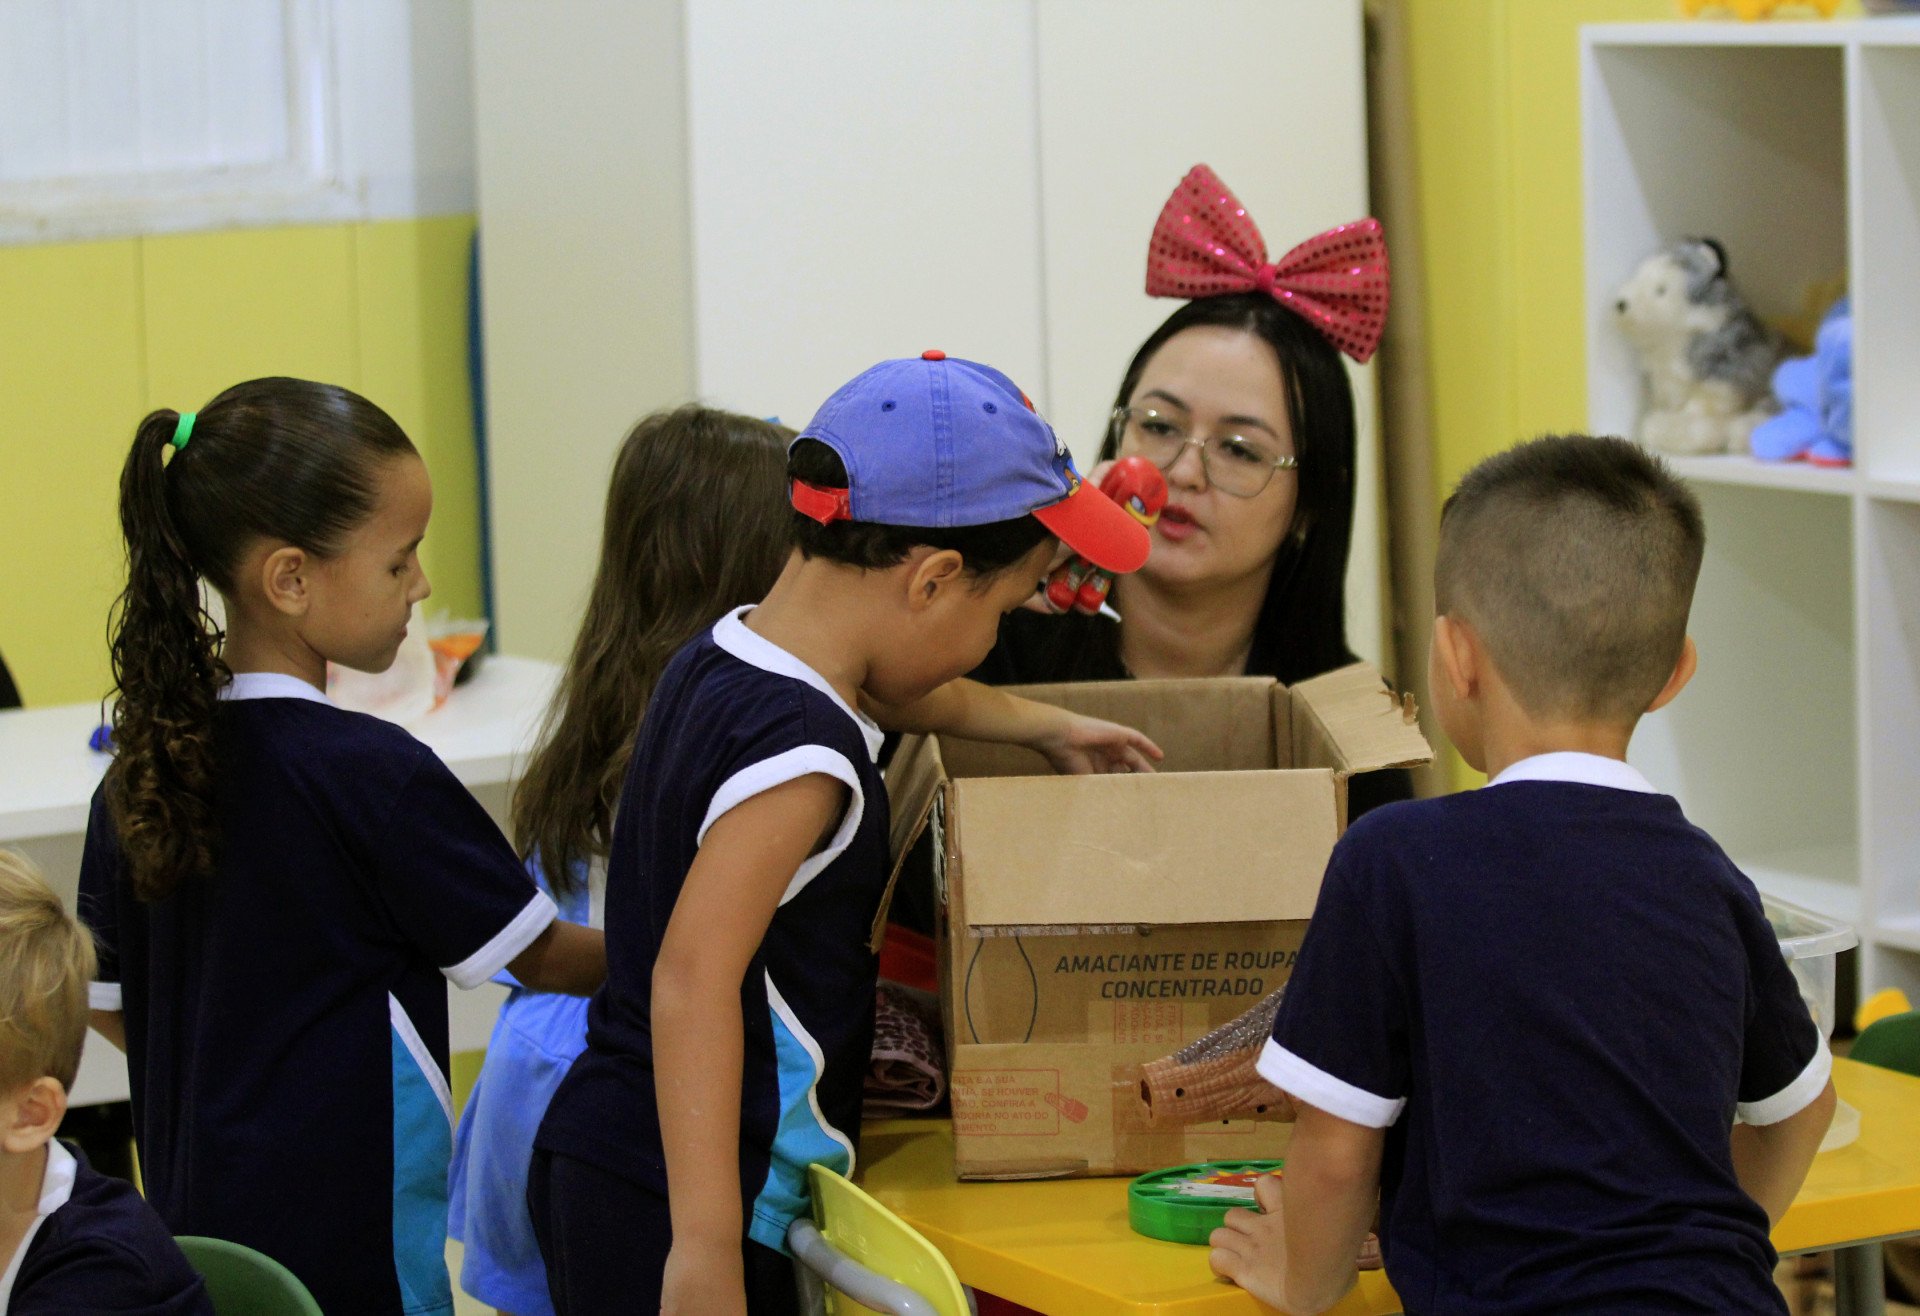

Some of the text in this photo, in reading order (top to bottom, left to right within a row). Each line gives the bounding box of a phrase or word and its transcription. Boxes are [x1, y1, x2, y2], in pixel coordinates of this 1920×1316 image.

[1054, 951, 1299, 973] AMACIANTE DE ROUPA
[1101, 978, 1264, 999] CONCENTRADO
[982, 1088, 993, 1096] SE
[997, 1087, 1040, 1096] HOUVER
[982, 1100, 1025, 1108] CONFIRA
[995, 1111, 1009, 1120] NO
[1013, 1111, 1032, 1120] ATO
[1035, 1111, 1048, 1120] DO
